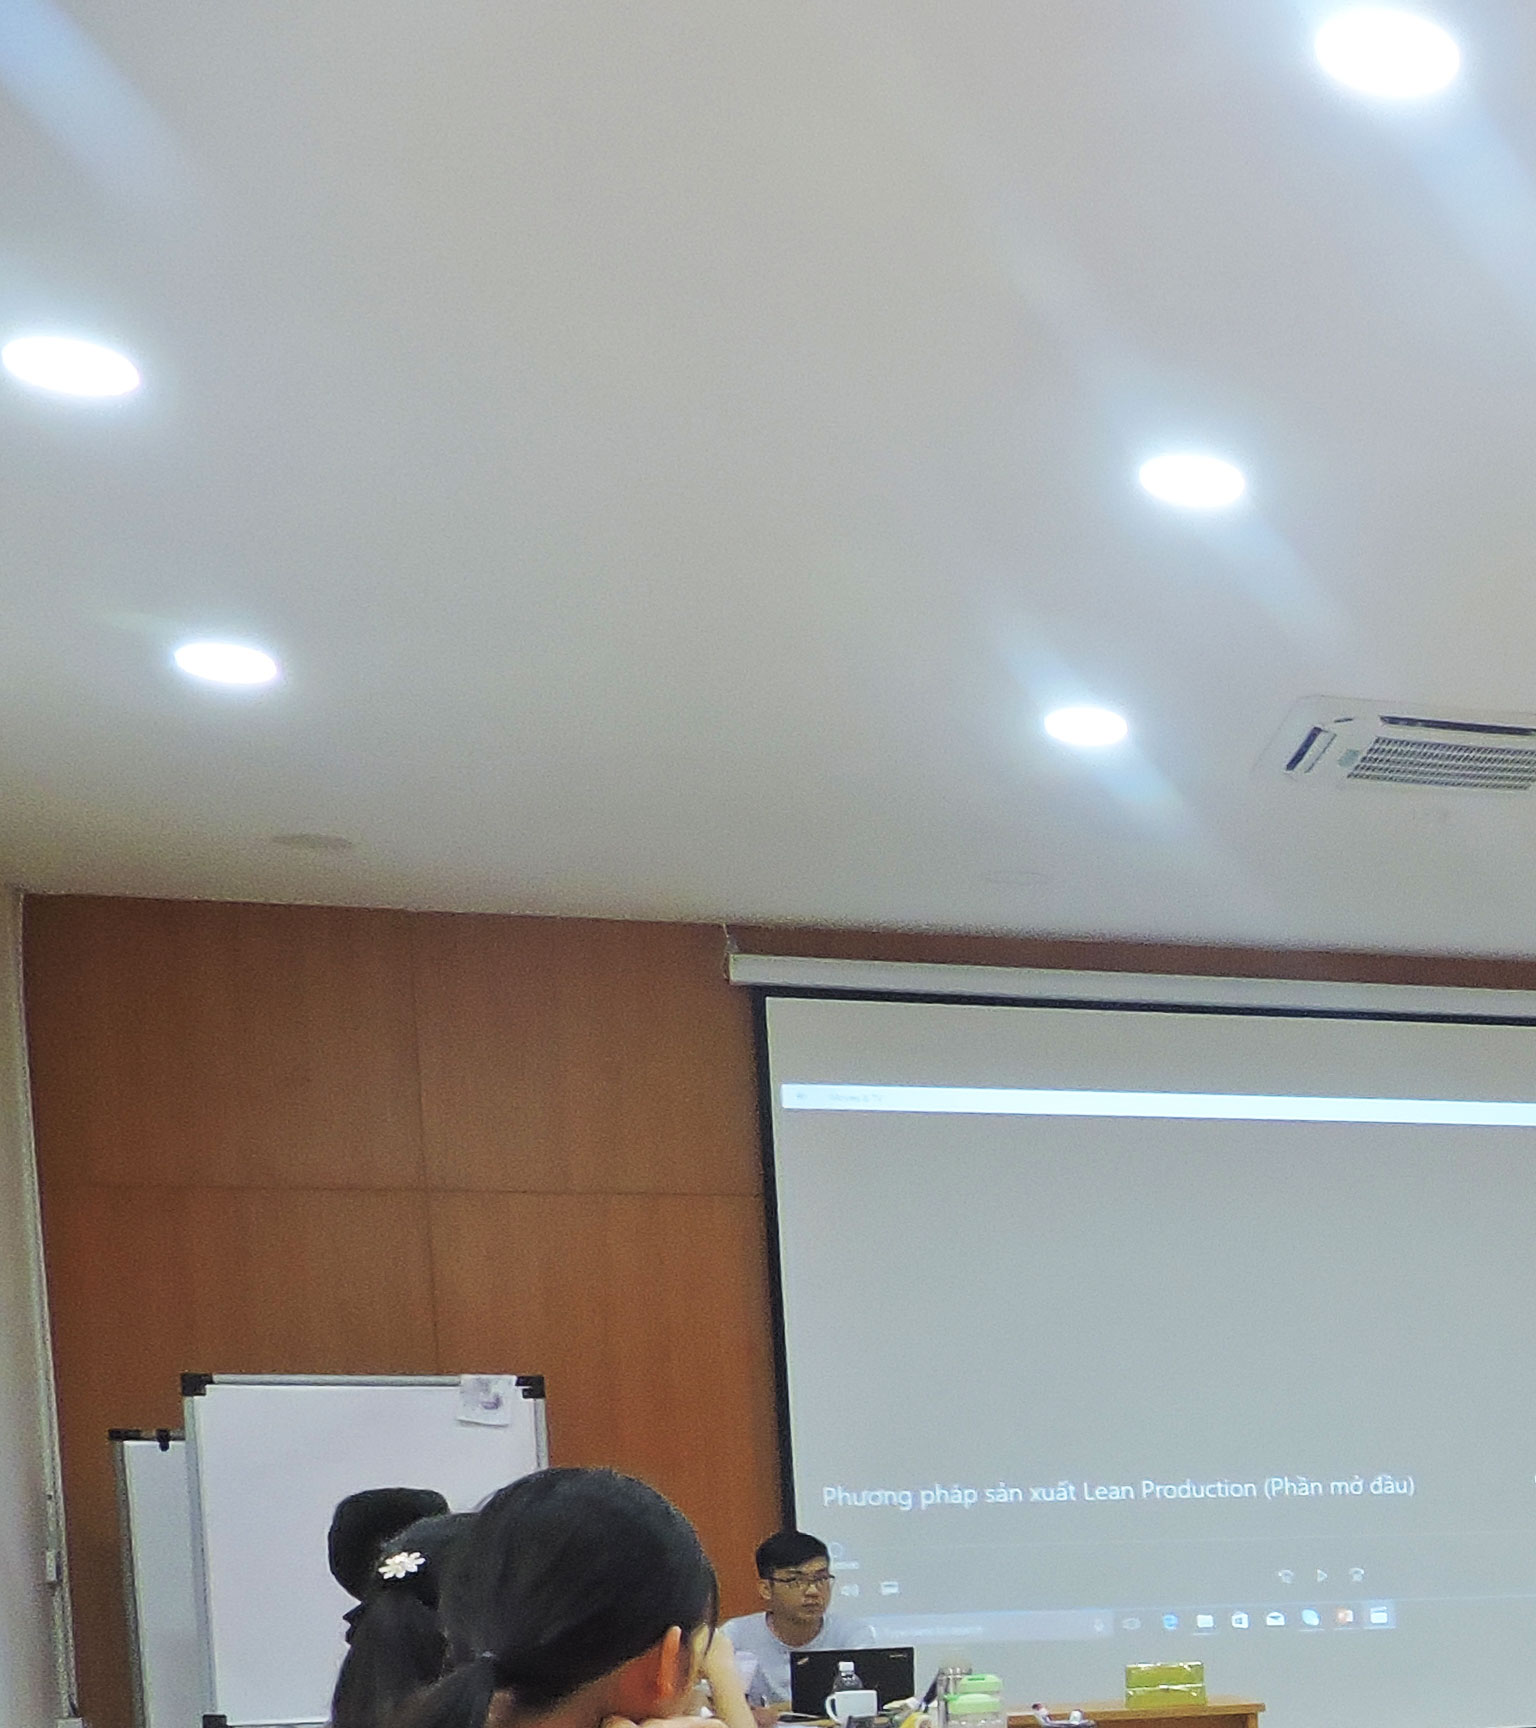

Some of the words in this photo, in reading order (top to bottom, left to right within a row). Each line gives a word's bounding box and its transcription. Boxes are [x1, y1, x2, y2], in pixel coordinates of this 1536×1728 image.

[822, 1484, 913, 1511] Phương
[920, 1483, 978, 1510] pháp
[984, 1481, 1023, 1502] sản
[1028, 1480, 1077, 1502] xuất
[1083, 1481, 1135, 1501] Lean
[1141, 1478, 1257, 1500] Production
[1263, 1475, 1323, 1500] (Phần
[1329, 1475, 1365, 1496] mở
[1369, 1472, 1415, 1499] đầu)
